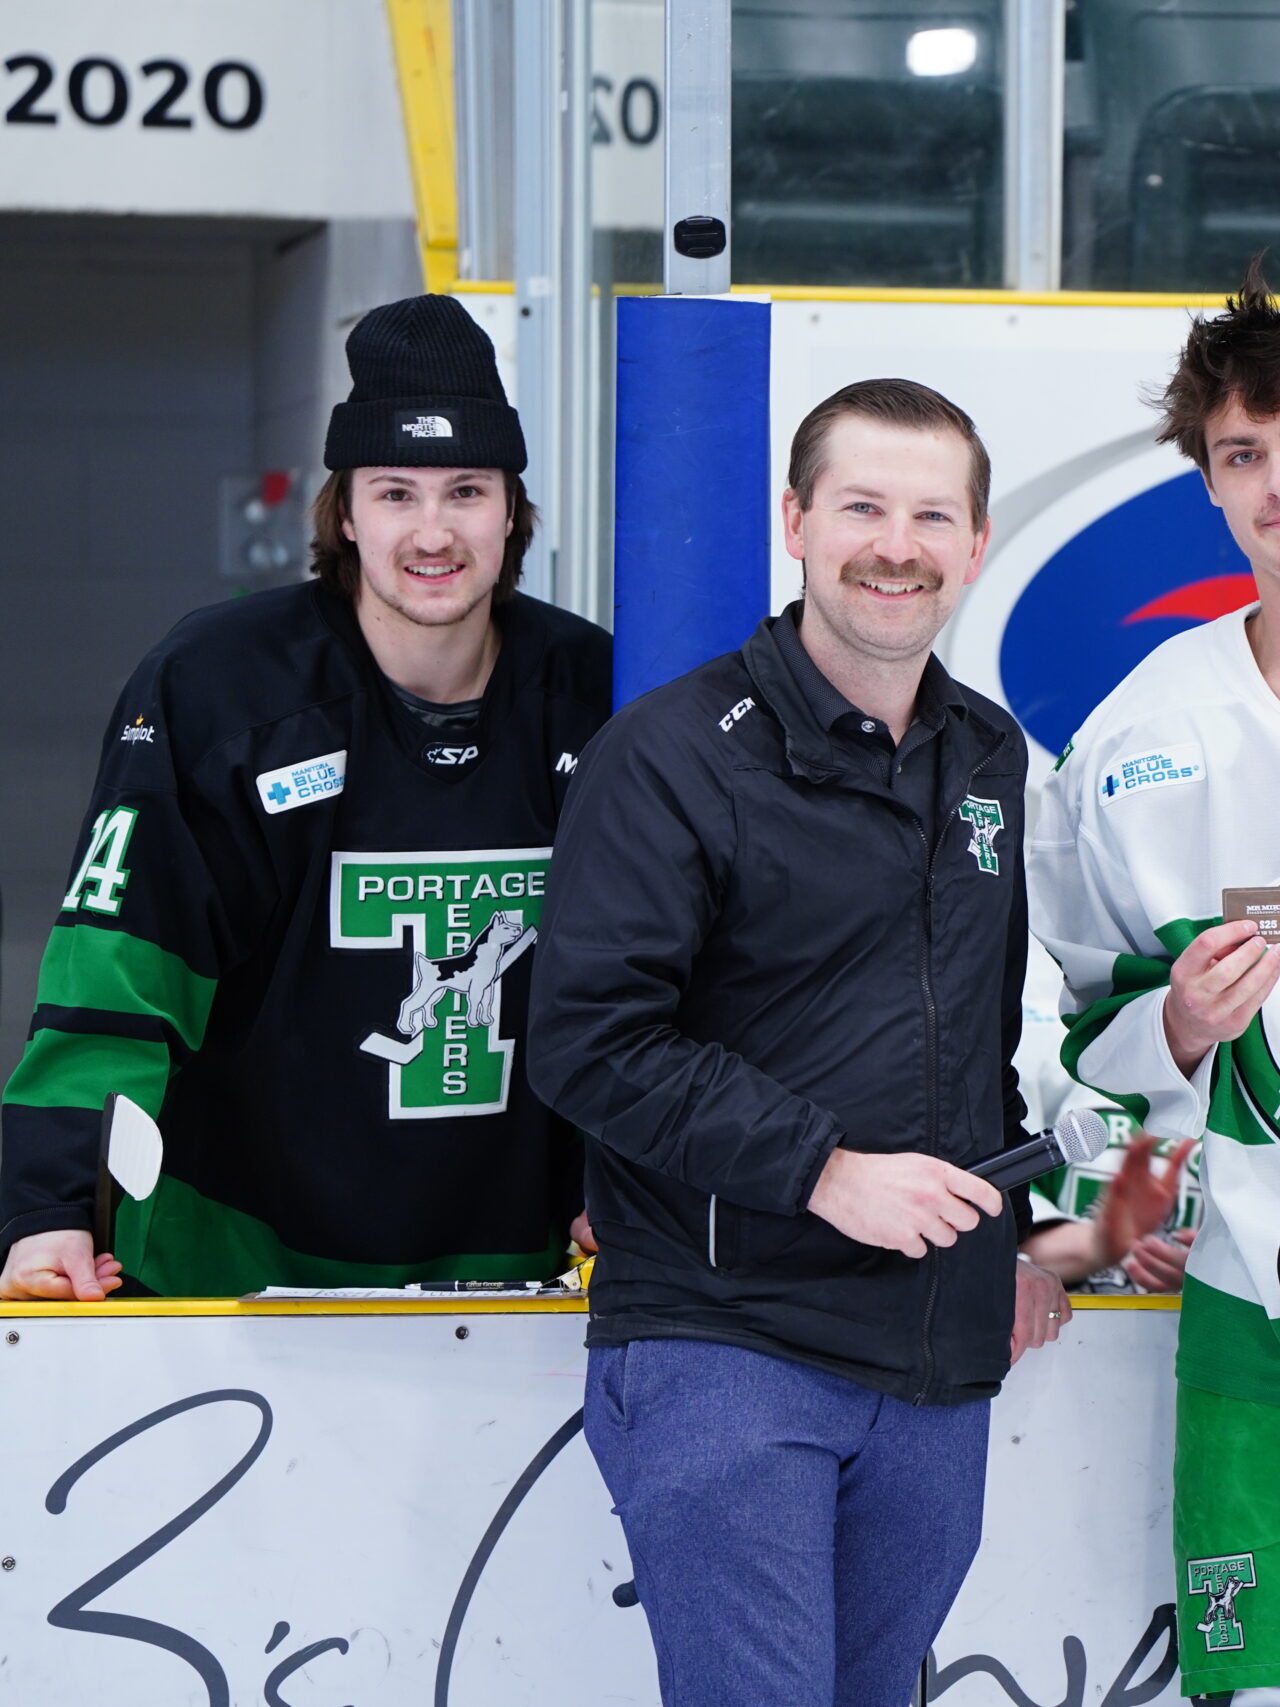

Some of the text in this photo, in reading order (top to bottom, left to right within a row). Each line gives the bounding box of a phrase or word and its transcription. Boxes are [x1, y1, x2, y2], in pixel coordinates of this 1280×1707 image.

[4, 55, 264, 130] 2020
[416, 416, 436, 424] THE
[412, 430, 437, 438] FACE
[718, 696, 756, 733] CCM
[434, 745, 479, 766] SP
[1121, 754, 1164, 769] MANITOBA
[291, 761, 329, 777] MANITOBA
[293, 766, 337, 788] BLUE
[1122, 758, 1174, 779] BLUE
[1125, 767, 1193, 790] CROSS
[297, 775, 345, 799] CROSS
[60, 804, 141, 917] 14
[357, 871, 547, 902] PORTAGE
[1259, 919, 1278, 929] $25
[1194, 1560, 1245, 1577] PORTAGE
